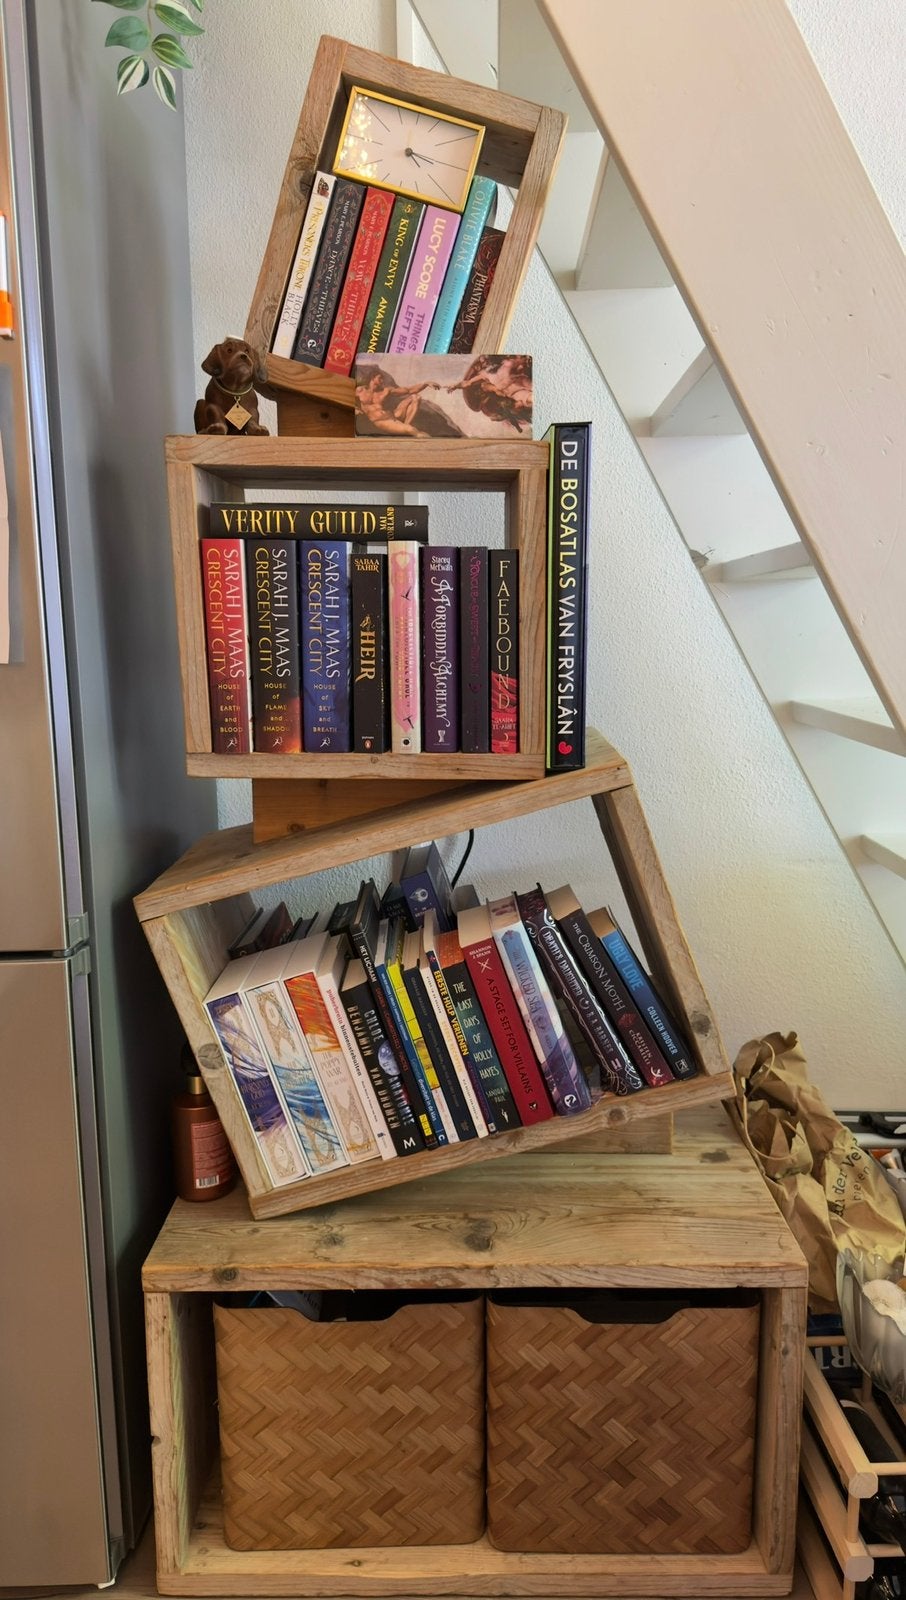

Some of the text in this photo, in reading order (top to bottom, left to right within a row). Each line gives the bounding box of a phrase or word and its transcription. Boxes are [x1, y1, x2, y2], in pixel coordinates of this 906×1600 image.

[394, 218, 410, 247] KING
[453, 190, 486, 270] OLIVIE BLAKE
[384, 258, 399, 289] ENVY
[415, 217, 447, 299] LUCY SCORE
[281, 292, 295, 326] BLACK
[289, 294, 303, 328] HOLLY
[313, 290, 329, 333] THIEVES
[376, 296, 388, 320] ANA
[463, 272, 489, 325] PHANTASMA
[341, 292, 358, 341] THIEVES
[395, 304, 416, 353] LEFT BEH
[408, 312, 426, 352] THINGS
[221, 509, 377, 536] VERITY GUILD
[379, 516, 387, 531] MAI
[354, 558, 380, 566] SABAA
[355, 564, 380, 573] TAHIR
[429, 563, 454, 572] McEwan
[431, 555, 451, 565] Stacey
[430, 576, 454, 595] A
[557, 441, 578, 735] DE BOSATLAS VAN FRYSLÂN
[206, 548, 226, 677] CRESCENT CITY
[223, 548, 245, 678] SARAH J. MAAS
[255, 547, 273, 676] CRESCENT CITY
[271, 548, 291, 678] SARAH J. MAAS
[307, 549, 323, 677] CRESCENT CITY
[323, 550, 341, 678] SARAH J. MAAS
[430, 594, 451, 663] FORBIDDEN
[496, 560, 512, 709] FAEBOUND
[355, 630, 376, 683] HEIR
[429, 661, 453, 728] ALCHEMY
[358, 944, 368, 956] HET
[571, 923, 623, 1011] THE CRIMSON MOTH
[609, 938, 642, 990] UGLY LOVE
[362, 957, 376, 981] LICHAAM
[515, 959, 535, 995] WICKED
[453, 981, 467, 994] THE
[457, 998, 473, 1012] LAST
[363, 1009, 384, 1041] CHLOE
[433, 970, 446, 995] EERSTE
[442, 996, 455, 1016] HULP
[450, 1017, 469, 1055] VERLENEN
[463, 1014, 480, 1029] DAYS
[647, 1005, 677, 1054] COLLEEN HOOVER
[327, 988, 361, 1076] puberbrein binnenstebuiten
[347, 1005, 372, 1056] BENJAMIN
[472, 1032, 481, 1045] OF
[485, 976, 532, 1094] A STAGE SET FOR VILLAINS
[473, 1048, 493, 1063] HOLLY
[480, 1065, 500, 1080] HAYES
[370, 1066, 382, 1085] VAN
[417, 1077, 430, 1099] diversiteit
[426, 1104, 435, 1112] de
[428, 1109, 438, 1121] klas
[832, 1170, 848, 1195] der
